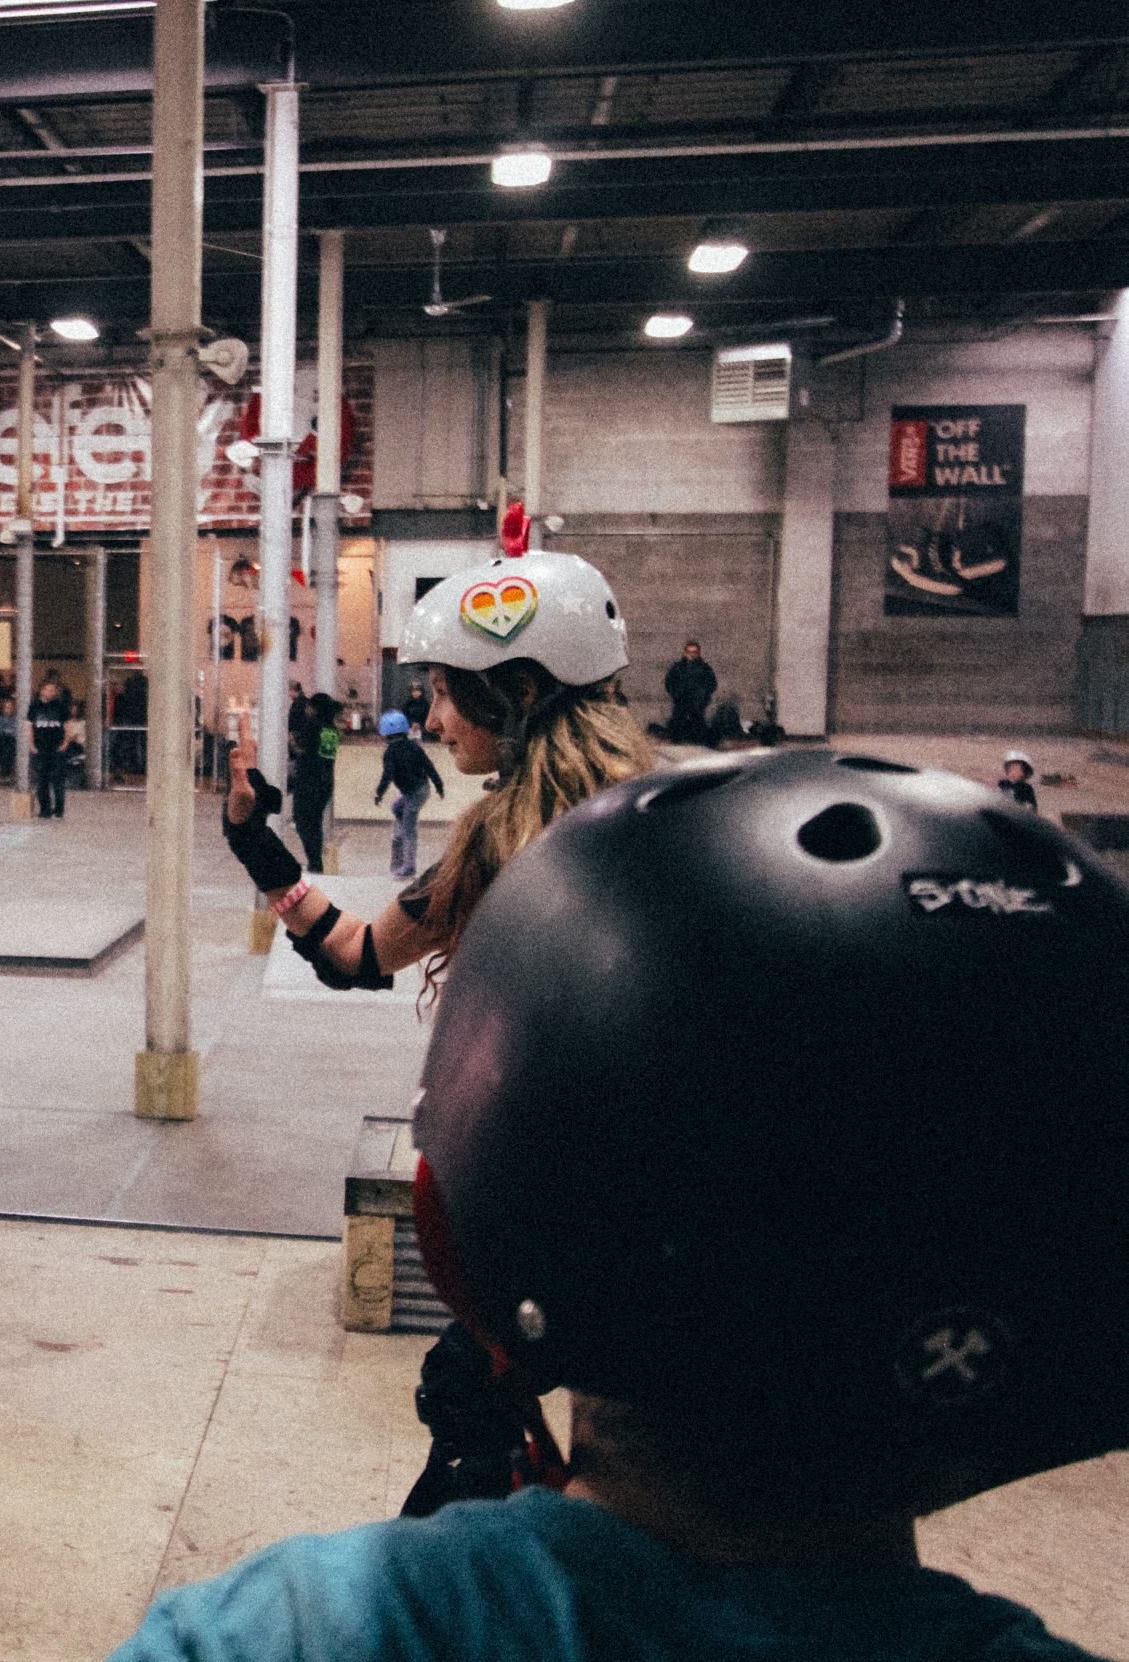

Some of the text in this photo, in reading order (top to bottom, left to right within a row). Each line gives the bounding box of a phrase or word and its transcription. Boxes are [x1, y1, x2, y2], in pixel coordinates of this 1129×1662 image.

[936, 443, 979, 462] THE
[934, 464, 1007, 486] WALL
[74, 492, 134, 512] THE
